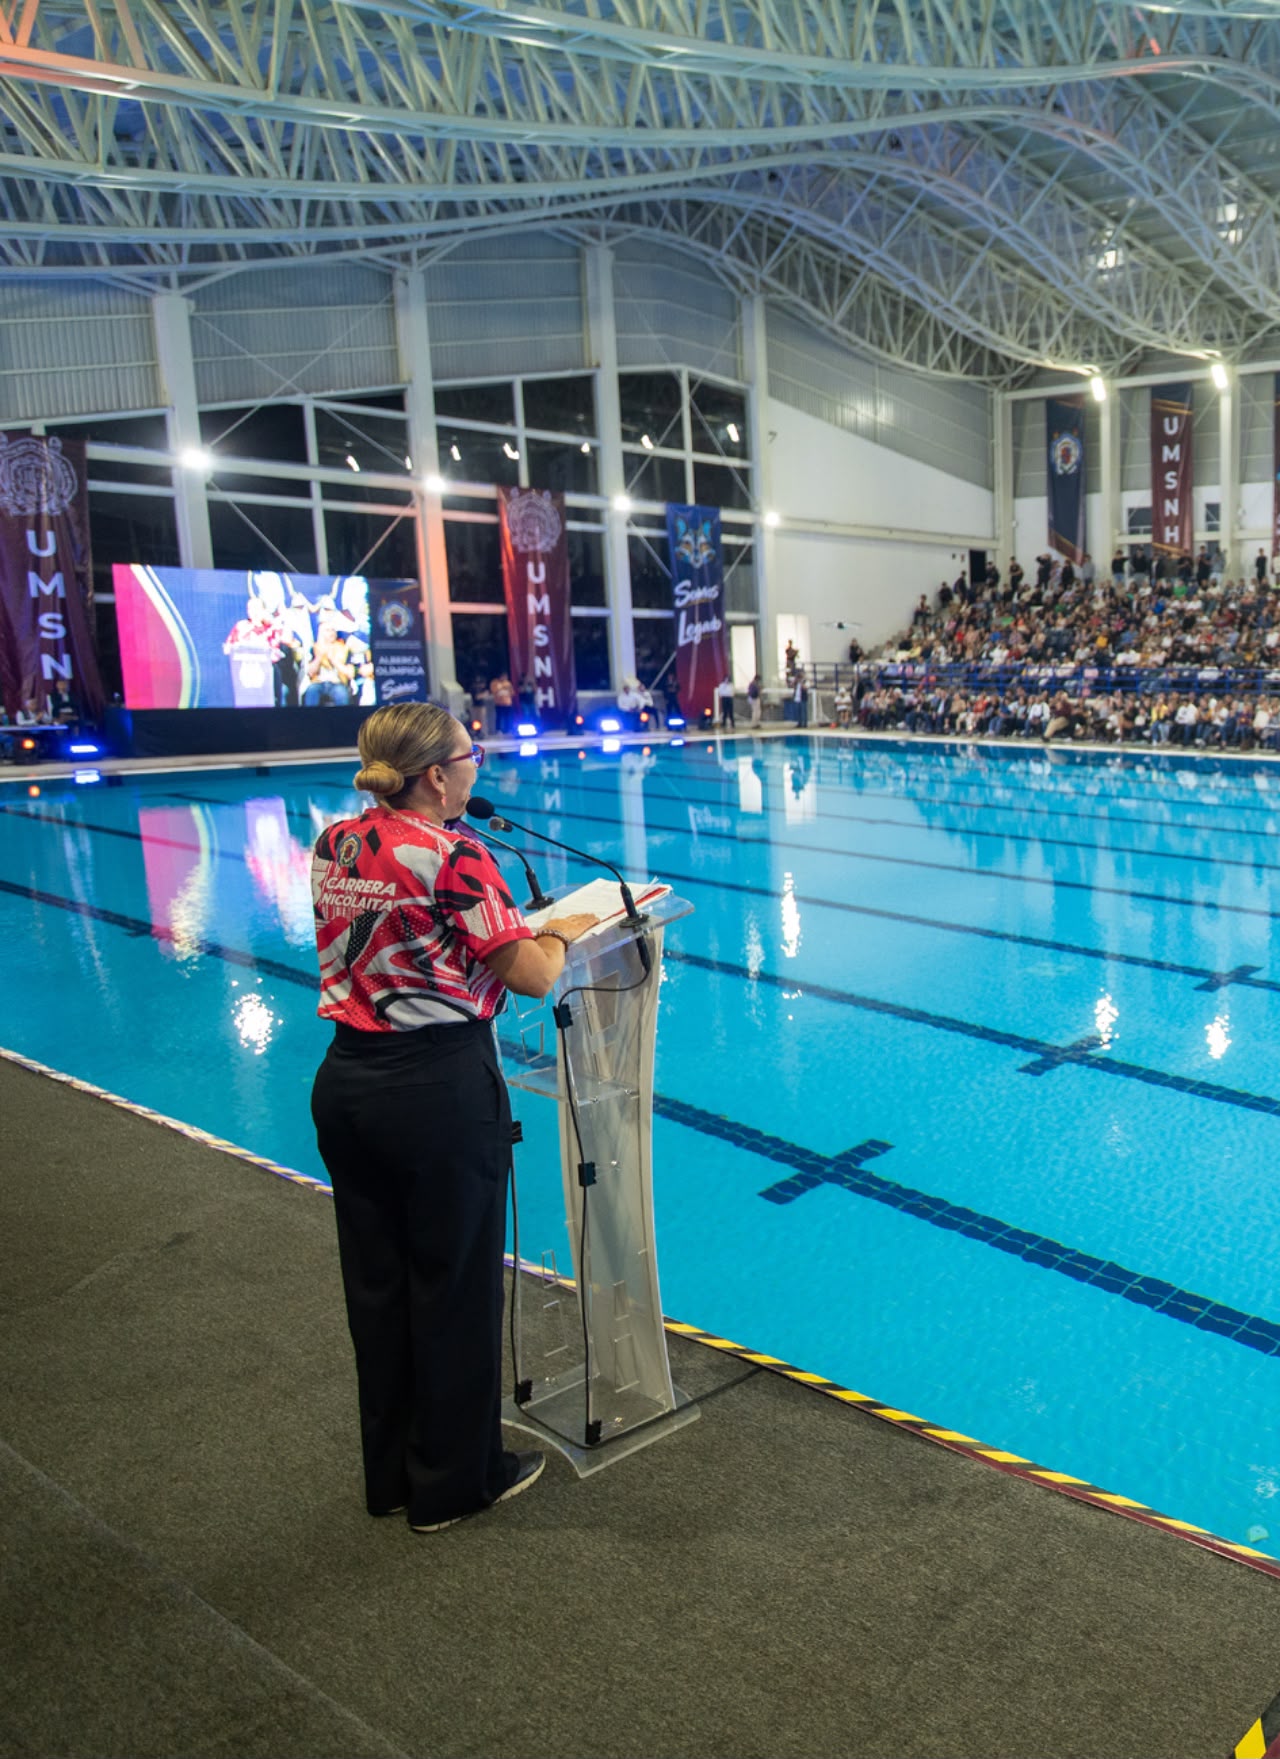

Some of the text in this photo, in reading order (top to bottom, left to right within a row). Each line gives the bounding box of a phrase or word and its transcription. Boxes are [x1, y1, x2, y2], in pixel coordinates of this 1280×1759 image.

[1160, 415, 1182, 544] UMSNH
[526, 560, 556, 709] UMSNH
[321, 892, 393, 912] NICOLAITA
[326, 876, 397, 897] CARRERA
